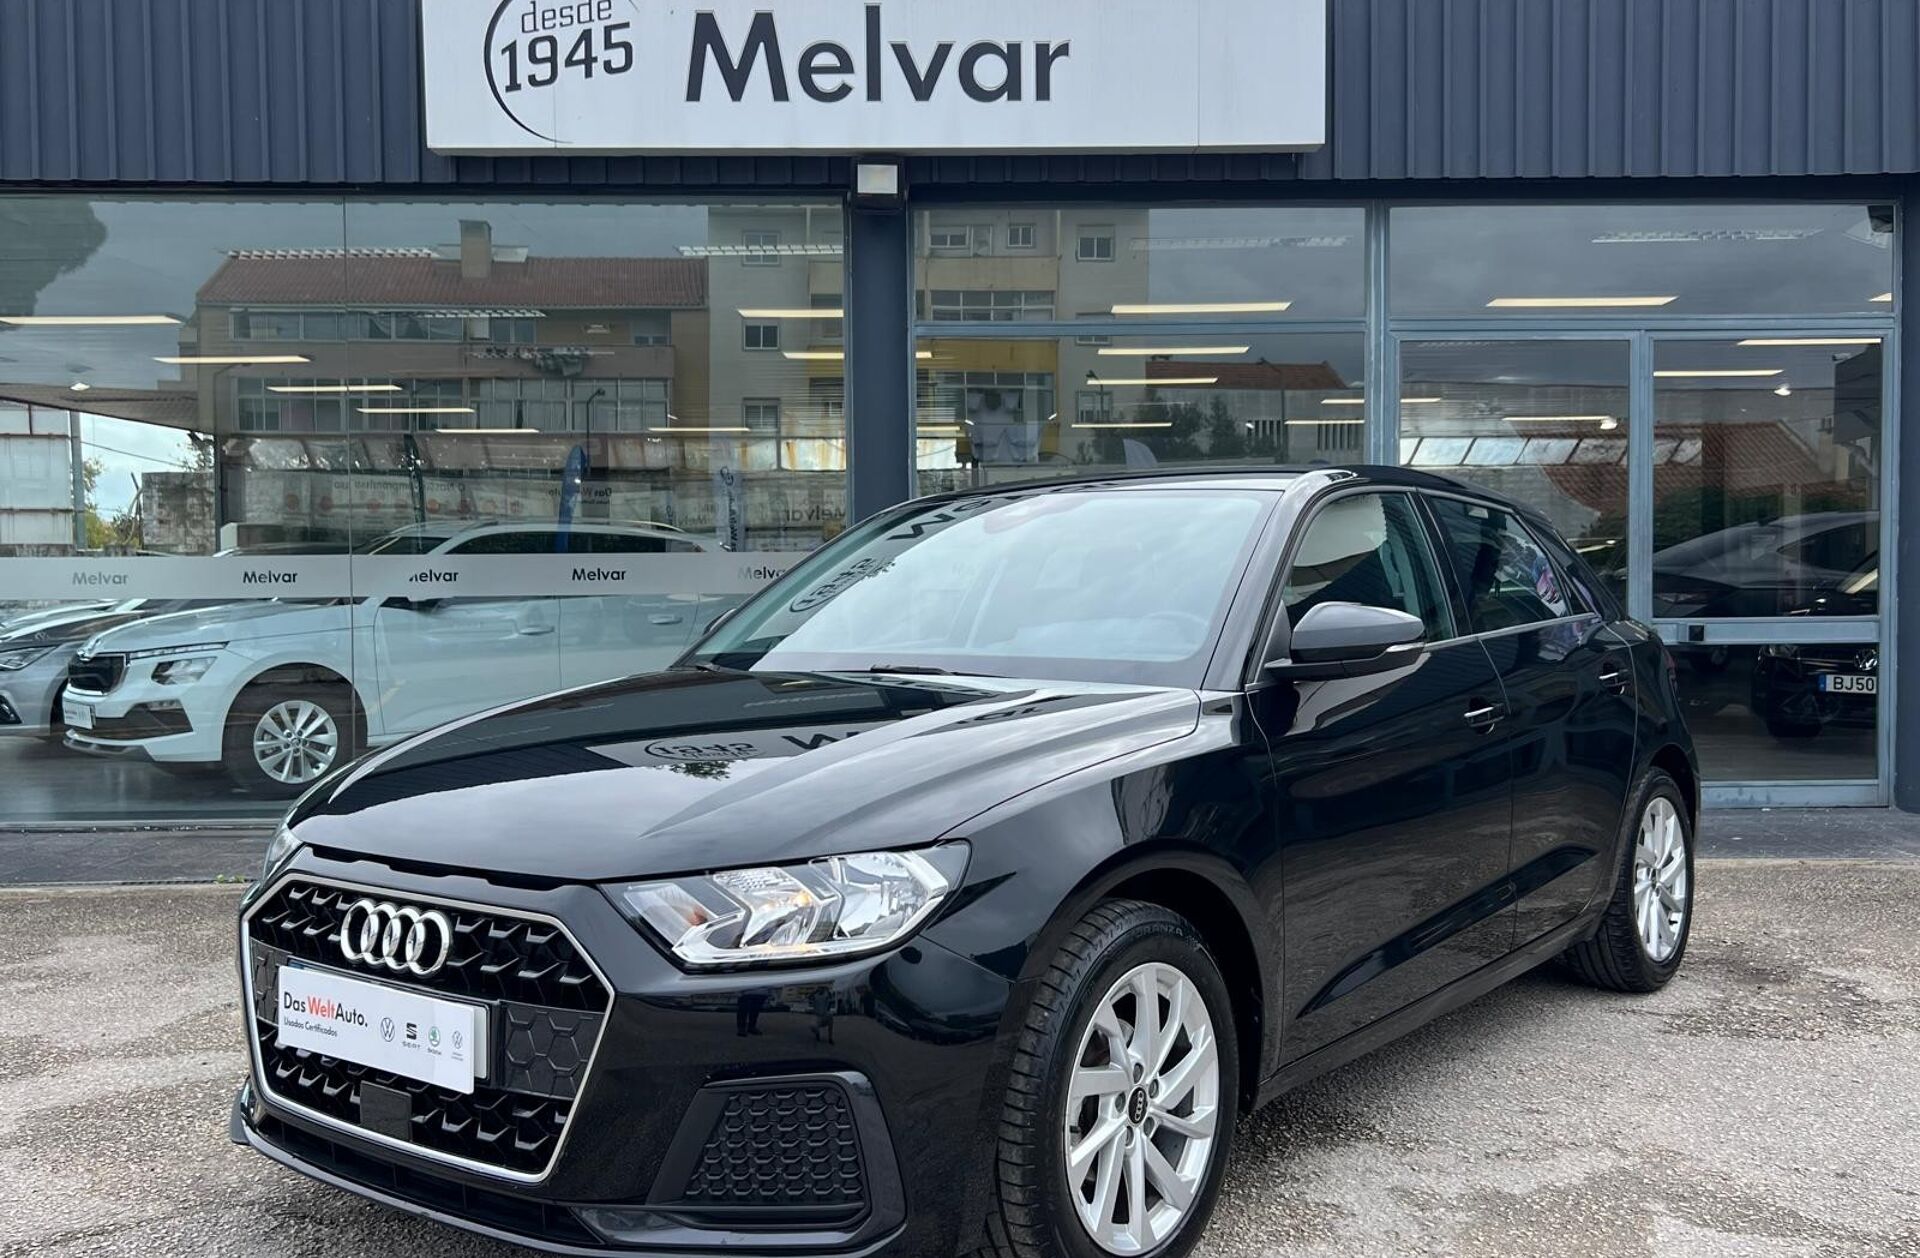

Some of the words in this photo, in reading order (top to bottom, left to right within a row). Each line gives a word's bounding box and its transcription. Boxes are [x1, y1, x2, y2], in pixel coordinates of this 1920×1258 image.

[521, 0, 613, 34] desde
[501, 21, 634, 93] 1945
[685, 2, 1071, 103] Melvar
[72, 571, 128, 586] Melvar
[242, 569, 298, 584] Melvar
[571, 567, 627, 581] Melvar
[1832, 676, 1875, 692] BJ50
[284, 991, 306, 1013] Das
[307, 995, 369, 1028] WeltAuto.
[305, 1021, 338, 1037] Certificados
